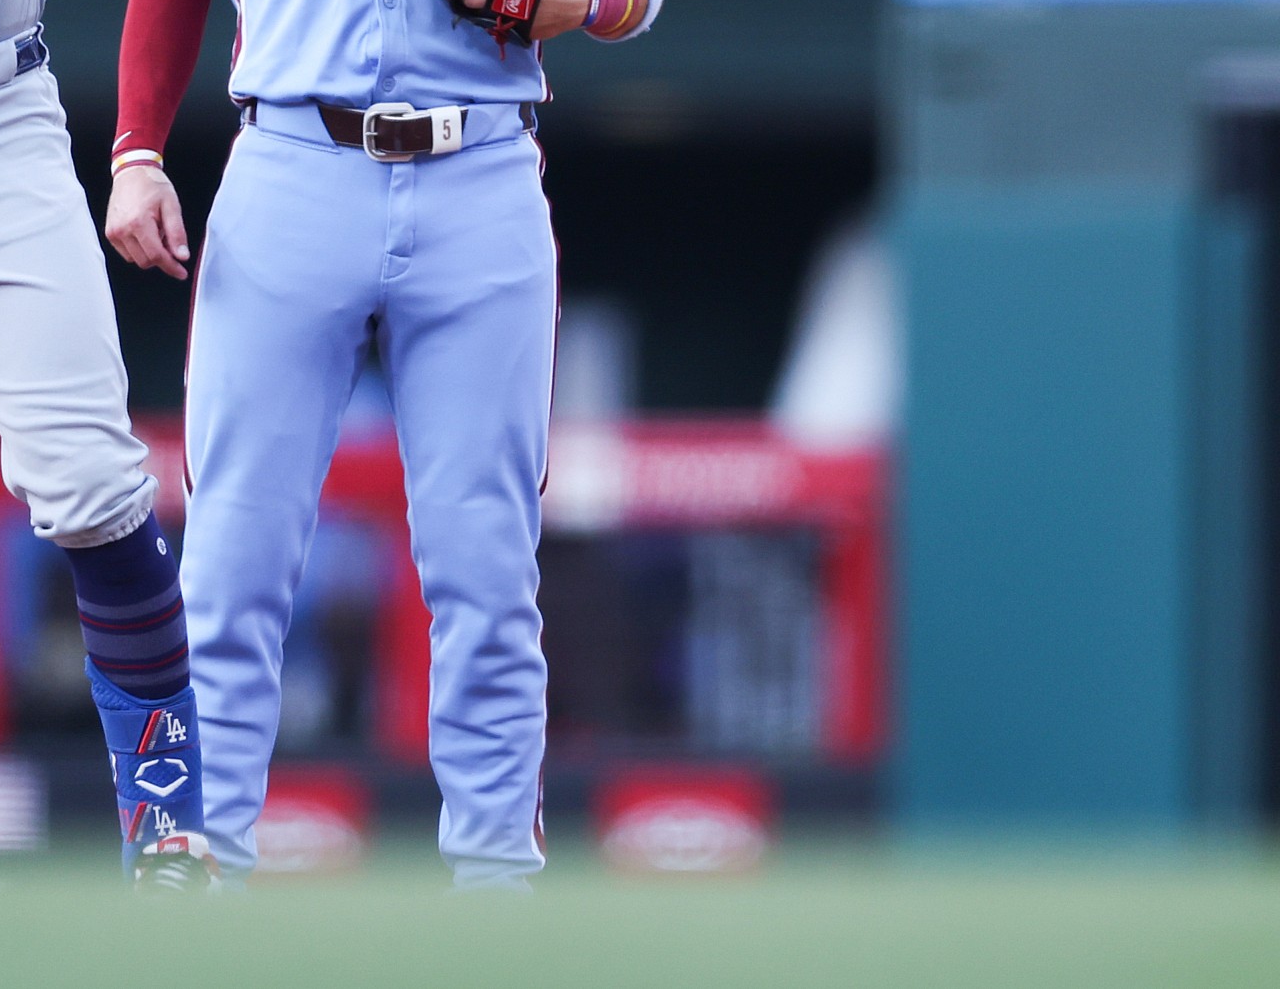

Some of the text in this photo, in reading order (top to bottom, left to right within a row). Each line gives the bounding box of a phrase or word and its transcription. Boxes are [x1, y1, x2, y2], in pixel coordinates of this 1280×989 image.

[442, 119, 451, 141] 5
[166, 712, 187, 743] LA
[153, 805, 177, 836] LA
